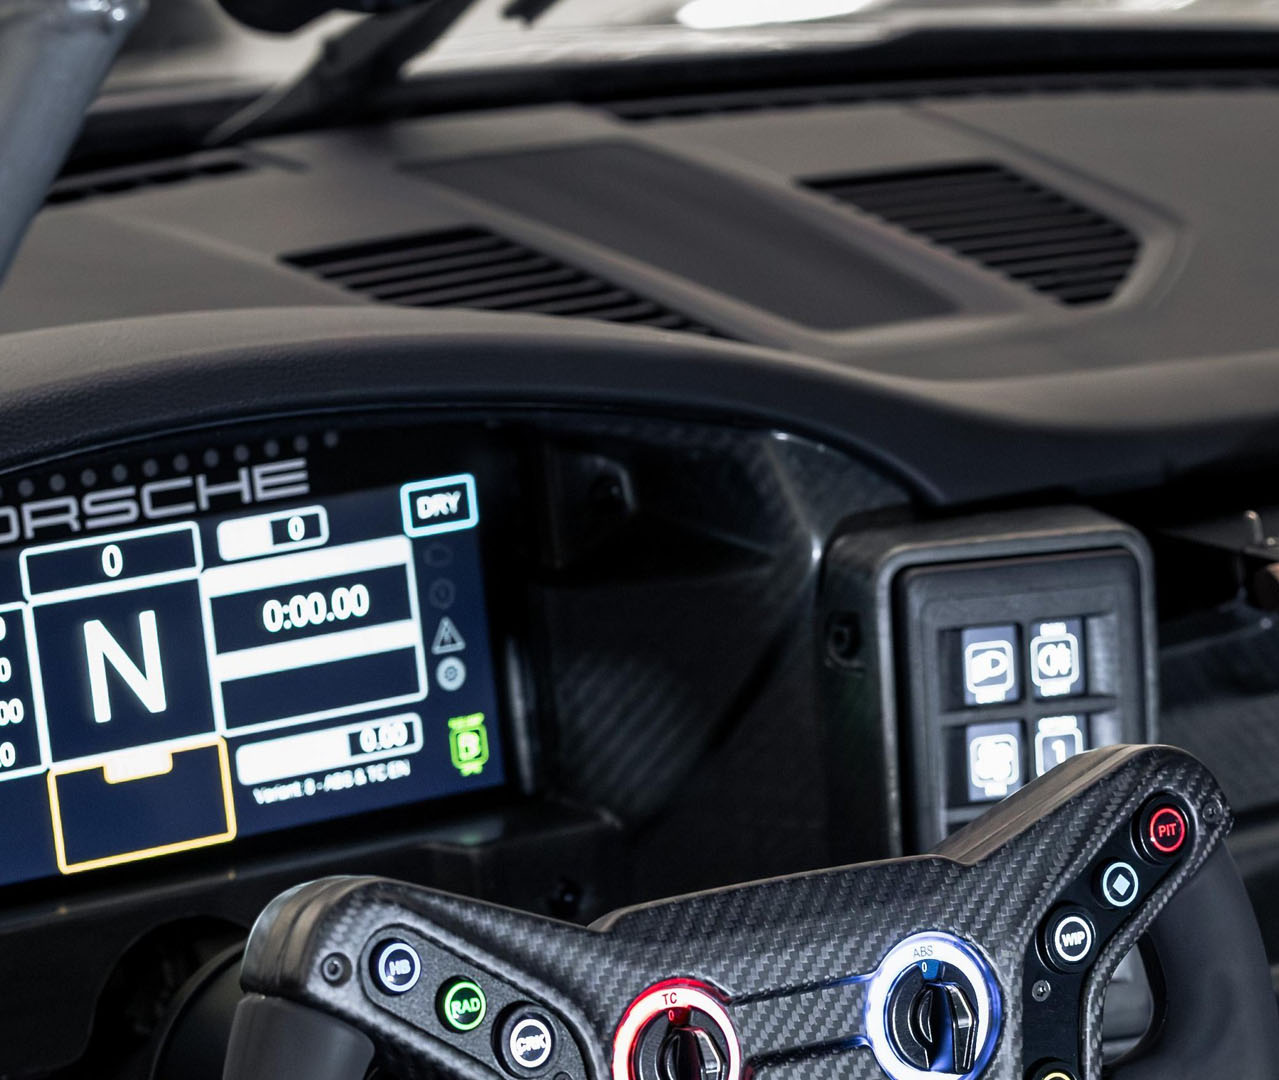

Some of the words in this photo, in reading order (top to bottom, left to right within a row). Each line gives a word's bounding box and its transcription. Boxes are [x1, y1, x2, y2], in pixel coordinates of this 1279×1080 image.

[417, 491, 461, 518] DRY
[288, 516, 305, 541] 0
[102, 544, 123, 577] 0
[262, 584, 369, 632] 0:00.00
[84, 610, 167, 723] N
[1158, 823, 1177, 837] PIT
[1061, 931, 1085, 947] WIP
[913, 945, 933, 957] ABS
[921, 961, 928, 973] 0
[451, 998, 481, 1016] RAD
[662, 992, 677, 1005] TC
[668, 1009, 675, 1021] 0
